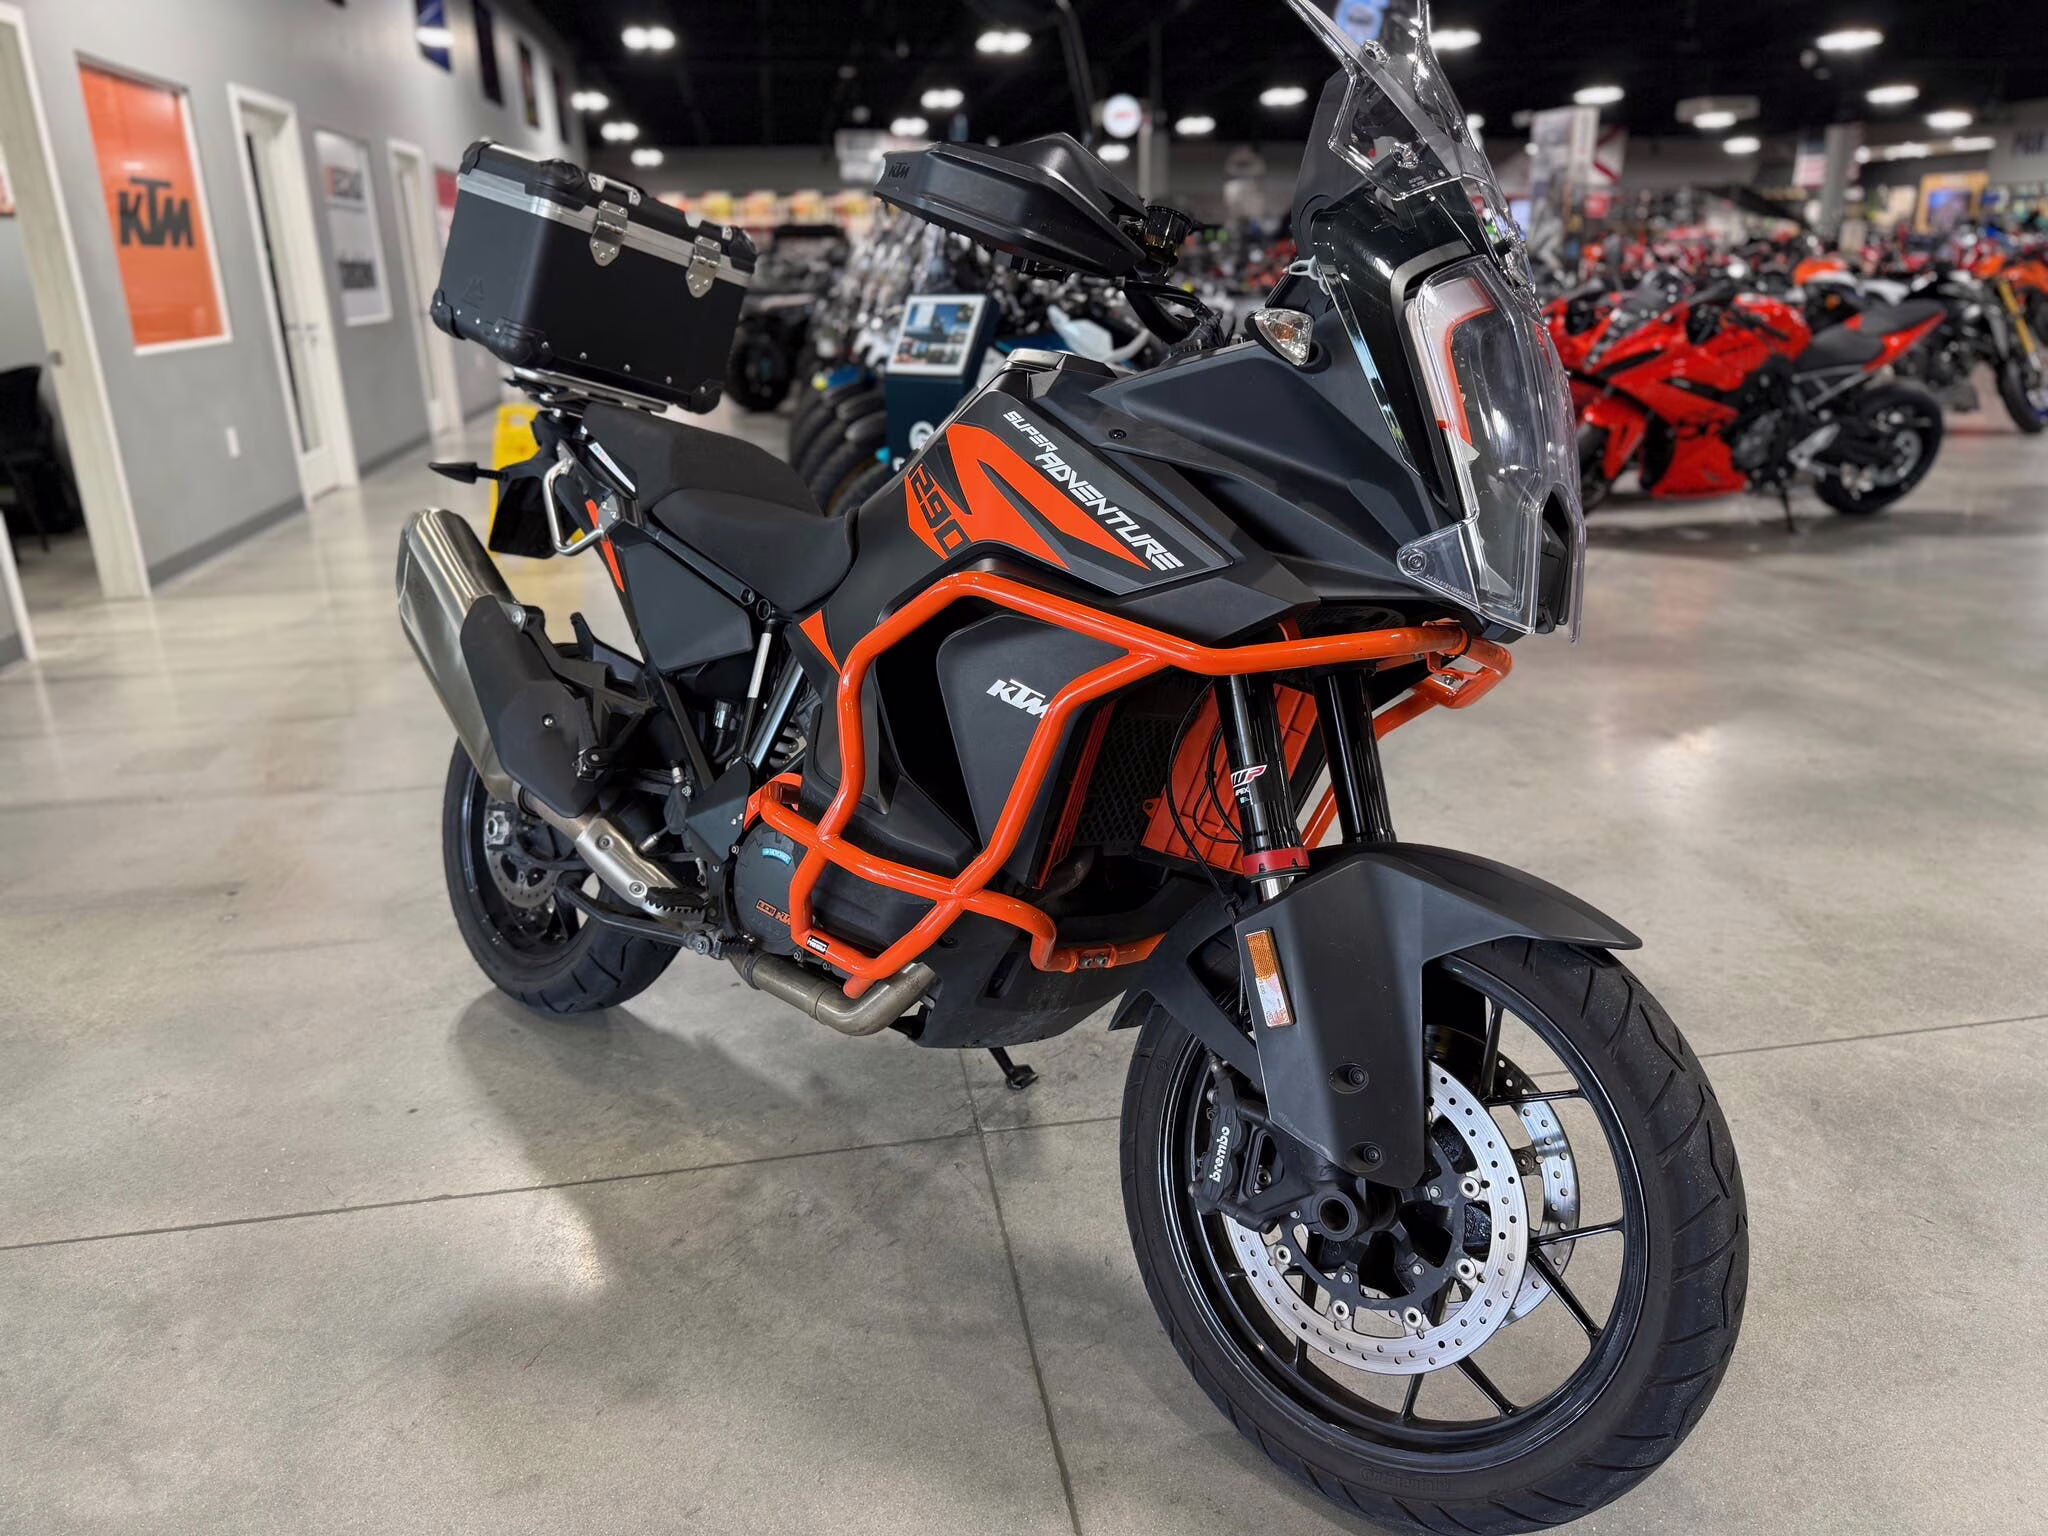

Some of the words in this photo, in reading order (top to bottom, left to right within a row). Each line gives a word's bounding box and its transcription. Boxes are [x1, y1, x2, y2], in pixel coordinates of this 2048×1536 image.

[887, 161, 910, 178] KTM
[118, 176, 194, 247] KTM
[1003, 411, 1058, 452] SUPER
[1035, 452, 1185, 571] ADVENTURE
[986, 679, 1049, 719] KTM
[1209, 1126, 1230, 1182] brembo
